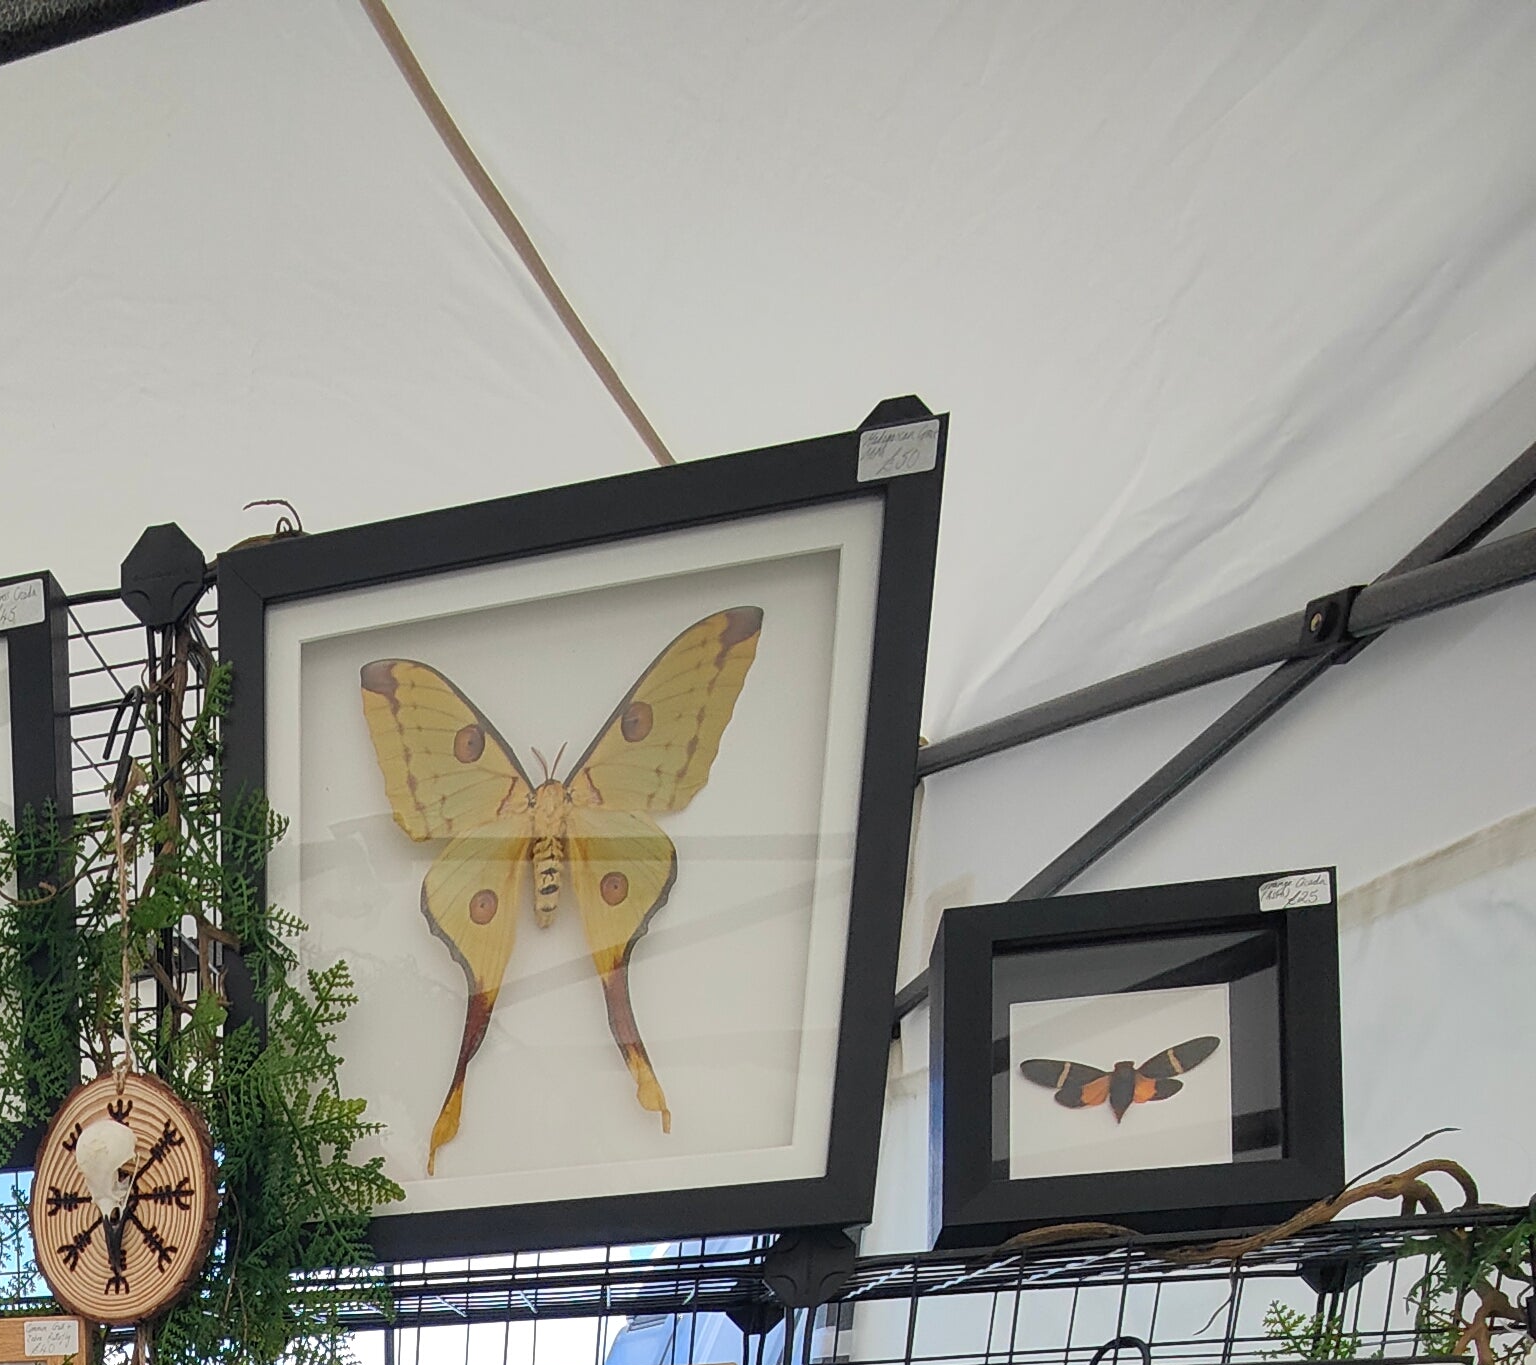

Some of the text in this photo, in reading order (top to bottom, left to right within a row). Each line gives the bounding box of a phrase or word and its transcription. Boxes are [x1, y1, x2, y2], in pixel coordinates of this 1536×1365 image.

[876, 447, 920, 476] £50
[1284, 890, 1319, 909] £25
[30, 1343, 56, 1356] £40
